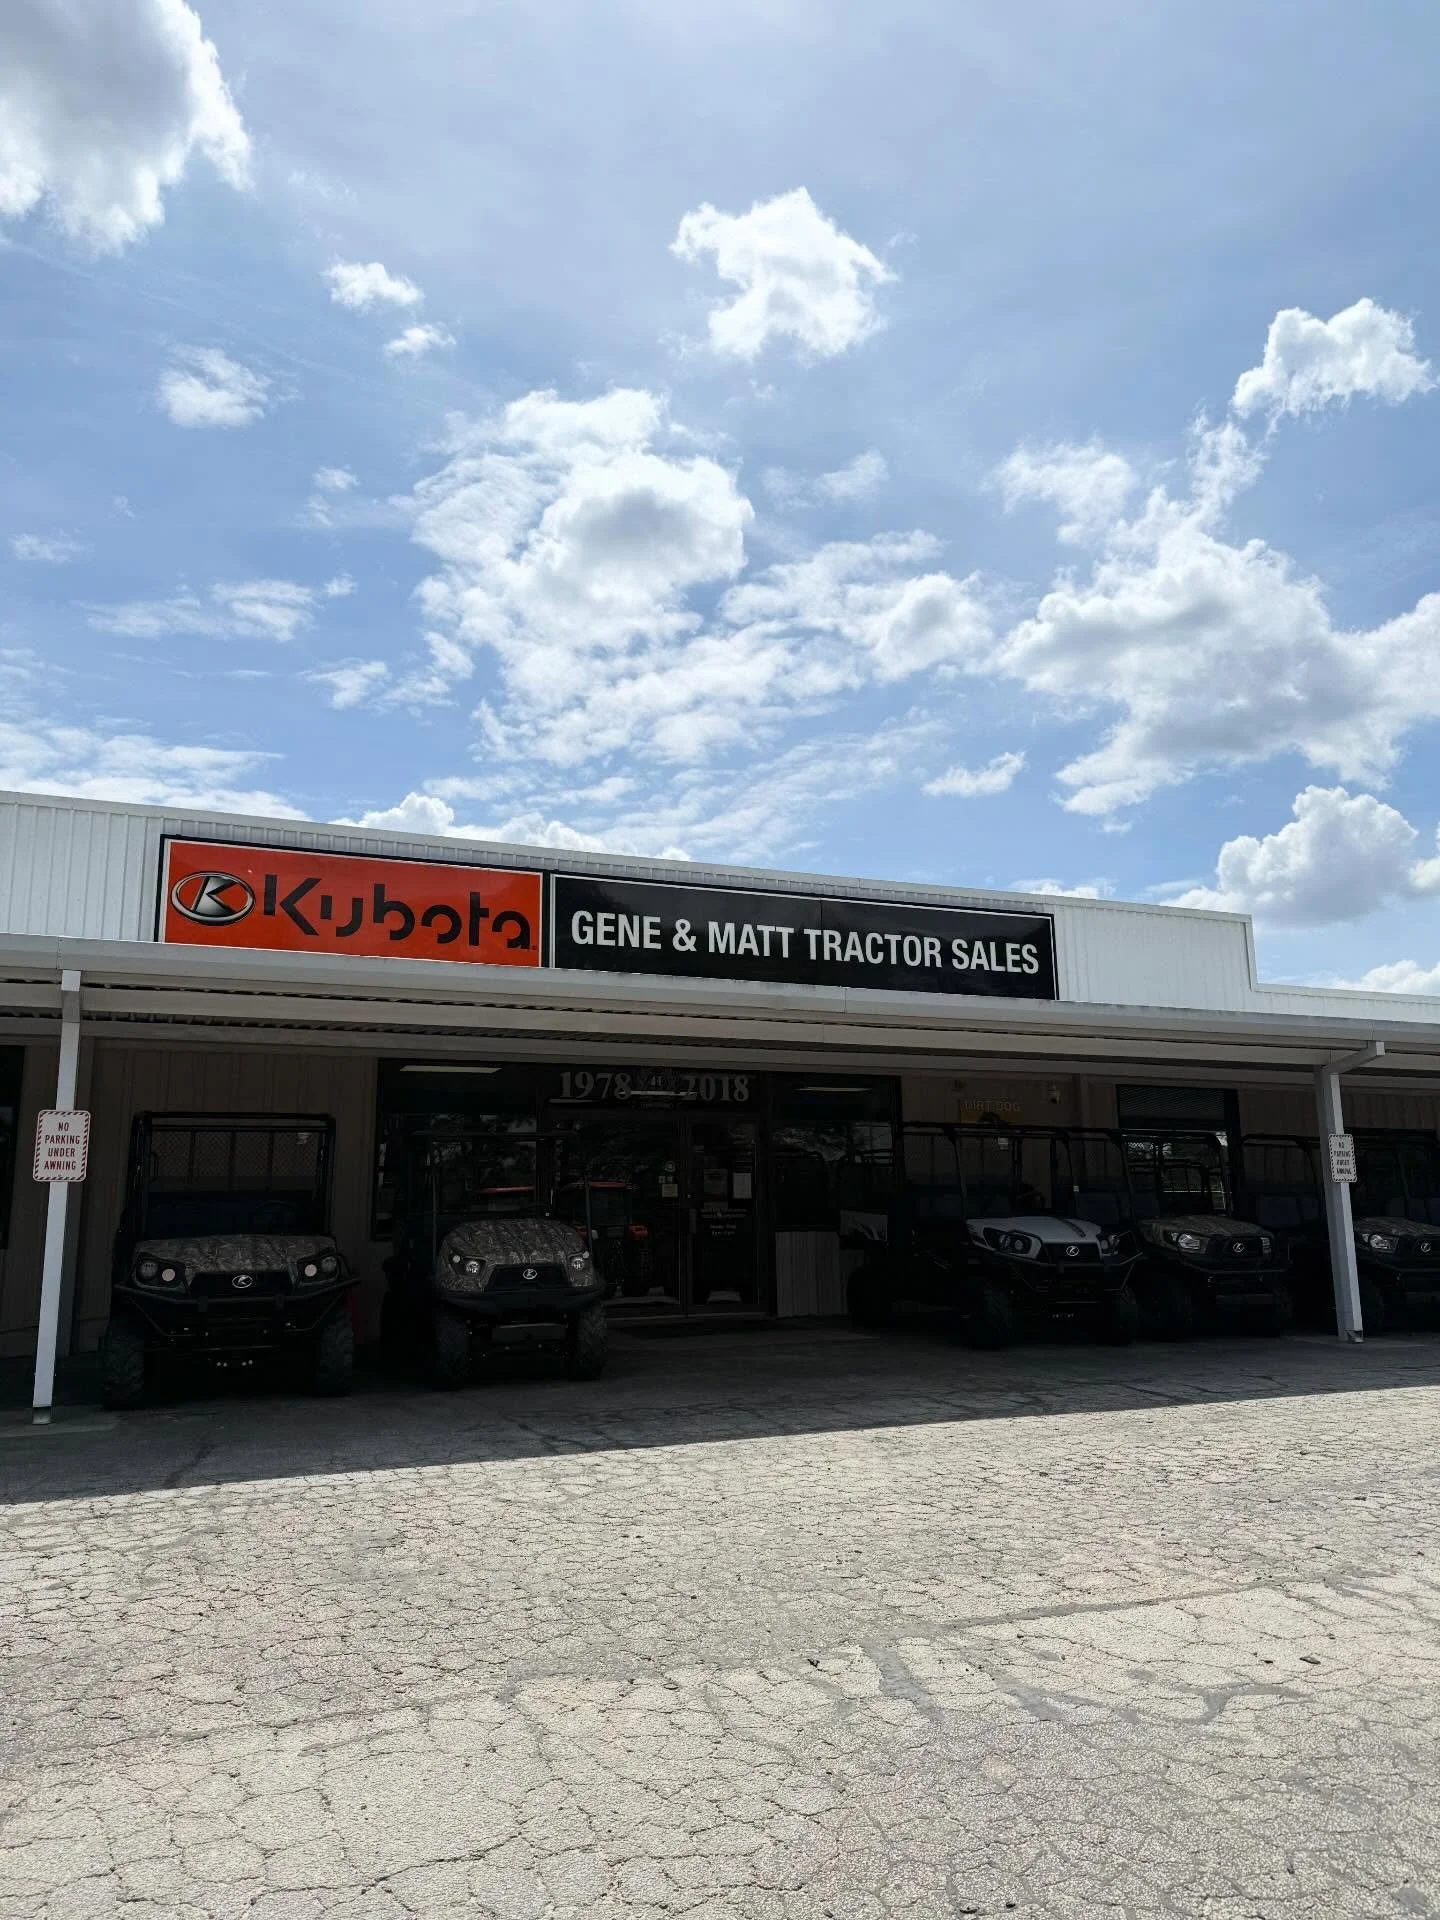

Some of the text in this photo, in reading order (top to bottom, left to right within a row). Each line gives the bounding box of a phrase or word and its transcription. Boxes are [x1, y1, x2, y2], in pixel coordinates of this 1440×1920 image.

[264, 874, 531, 950] Kubota
[571, 910, 1039, 974] GENE & MATT TRACTOR SALES
[560, 1071, 632, 1100] 1978
[683, 1074, 750, 1102] 2018
[58, 1122, 70, 1132] NO
[44, 1135, 81, 1145] PARKING
[48, 1148, 76, 1158] UNDER
[44, 1161, 77, 1170] AWNING
